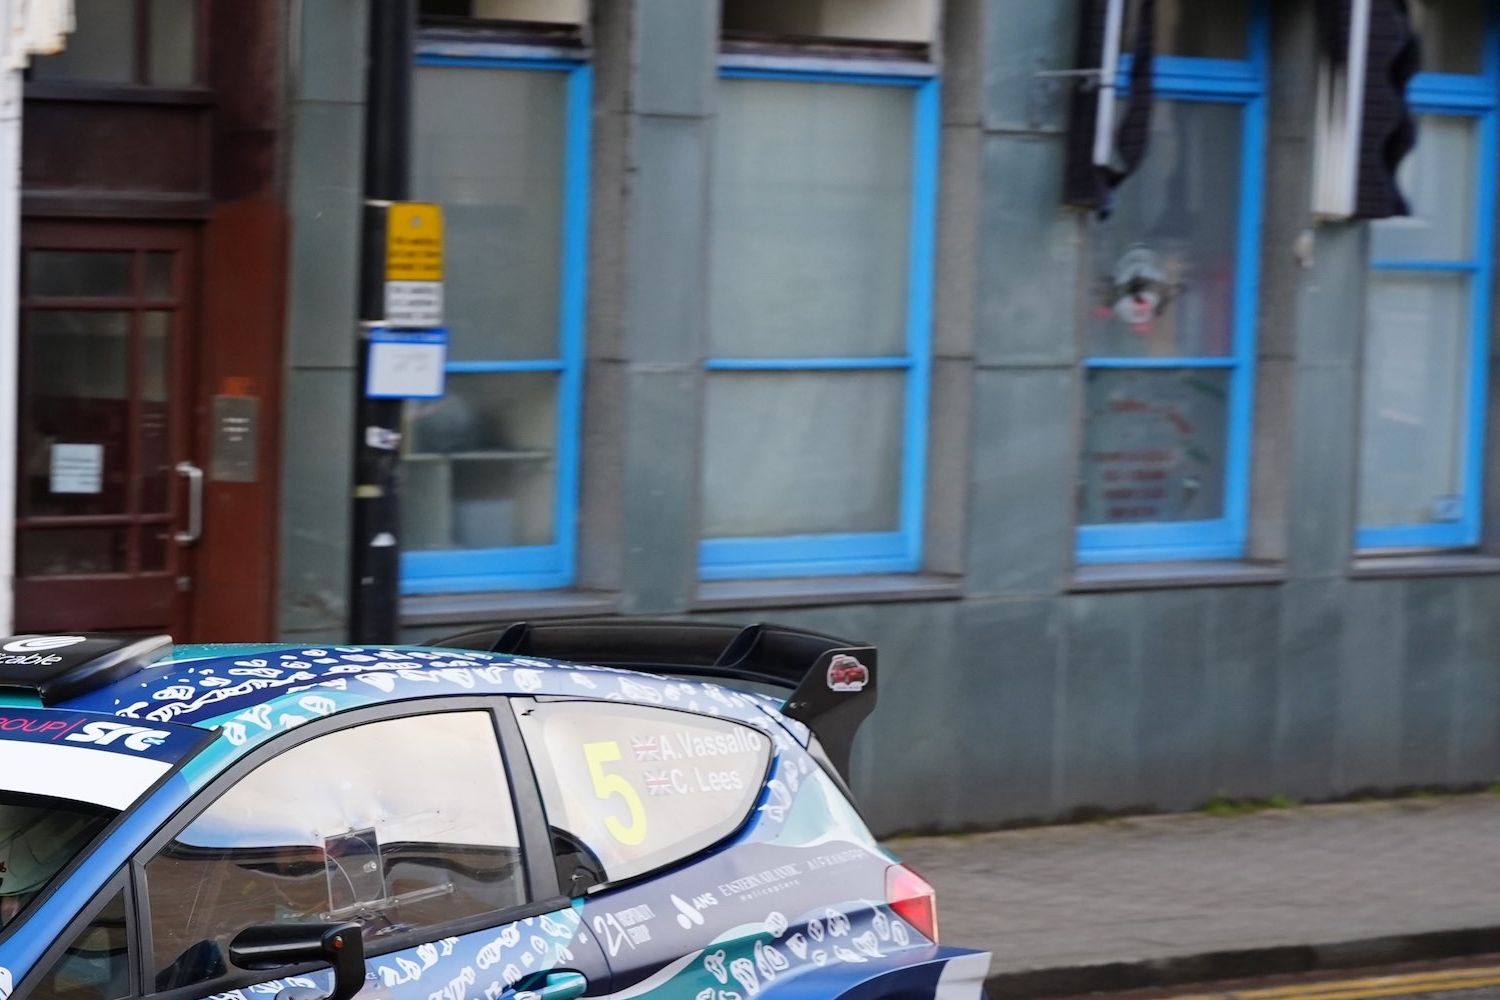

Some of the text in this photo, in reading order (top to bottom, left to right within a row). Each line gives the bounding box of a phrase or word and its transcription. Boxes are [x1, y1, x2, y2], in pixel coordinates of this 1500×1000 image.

[583, 741, 648, 847] 5
[694, 768, 743, 793] Lees
[593, 912, 635, 957] 21
